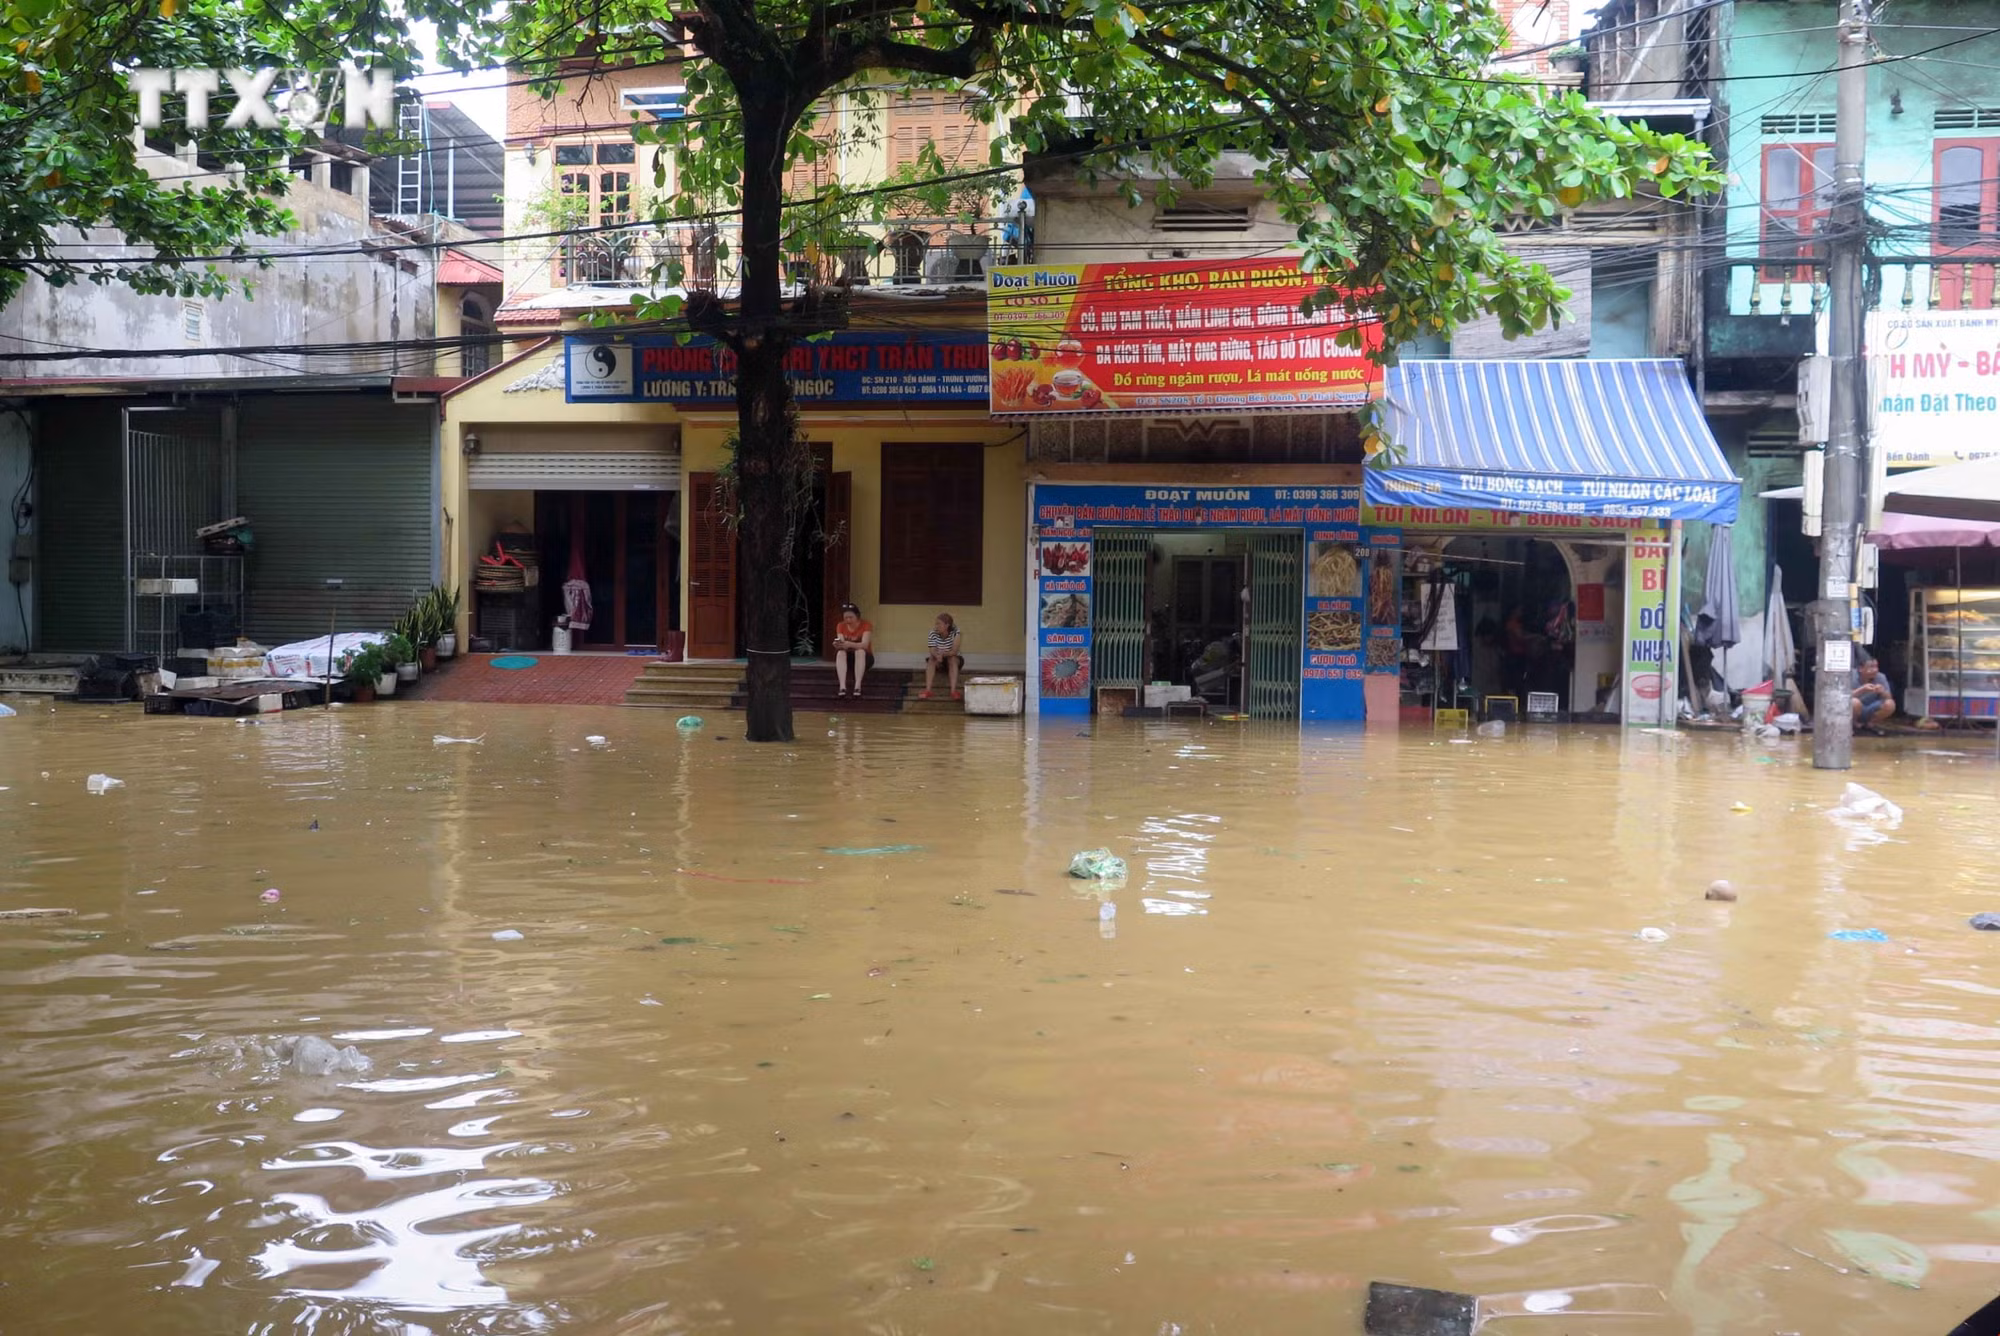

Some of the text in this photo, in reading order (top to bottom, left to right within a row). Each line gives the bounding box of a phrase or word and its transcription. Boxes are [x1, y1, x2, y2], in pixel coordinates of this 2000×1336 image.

[992, 270, 1078, 291] Đoạt Muôn
[1103, 267, 1154, 291] TỔNG
[1159, 271, 1203, 291] KHO,
[1119, 311, 1143, 330] TAM
[1204, 307, 1230, 328] LINH
[642, 341, 713, 373] PHÒNG
[816, 345, 870, 372] YHCT
[1096, 344, 1112, 365] BA
[1113, 340, 1140, 364] KÍCH
[1142, 339, 1166, 365] TÍM,
[1168, 338, 1193, 367] MẬT
[1194, 341, 1218, 362] ONG
[1220, 336, 1254, 363] RỪNG,
[1256, 335, 1278, 360] TÁO
[1280, 332, 1296, 360] ĐỎ
[1912, 341, 1951, 378] MỲ
[1135, 372, 1166, 388] rừng
[1169, 371, 1205, 387] ngâm
[1208, 371, 1243, 387] rượu,
[1247, 368, 1262, 383] Lá
[1265, 368, 1291, 383] mát
[1294, 366, 1329, 384] uống
[1331, 366, 1365, 381] nước
[643, 379, 691, 398] LƯƠNG
[694, 380, 707, 397] Y:
[795, 379, 835, 399] NGỌC
[1920, 392, 1949, 416] Đặt
[1955, 393, 1997, 412] Theo
[1145, 489, 1191, 503] ĐOẠT
[1196, 488, 1251, 501] MUÔN
[1275, 489, 1290, 500] ĐT:
[1293, 489, 1316, 500] 0399
[1341, 489, 1360, 500] 309
[1460, 470, 1484, 491] TÚI
[1486, 471, 1525, 493] BÓNG
[1527, 478, 1563, 498] SẠCH
[1582, 476, 1606, 497] TÚI
[1608, 480, 1651, 499] NILON
[1653, 482, 1684, 501] CÁC
[1684, 485, 1718, 508] LOẠI
[1076, 503, 1096, 520] BÁN
[1097, 503, 1123, 520] BUÔN
[1123, 504, 1144, 522] BÁN
[1410, 507, 1470, 525] NILON
